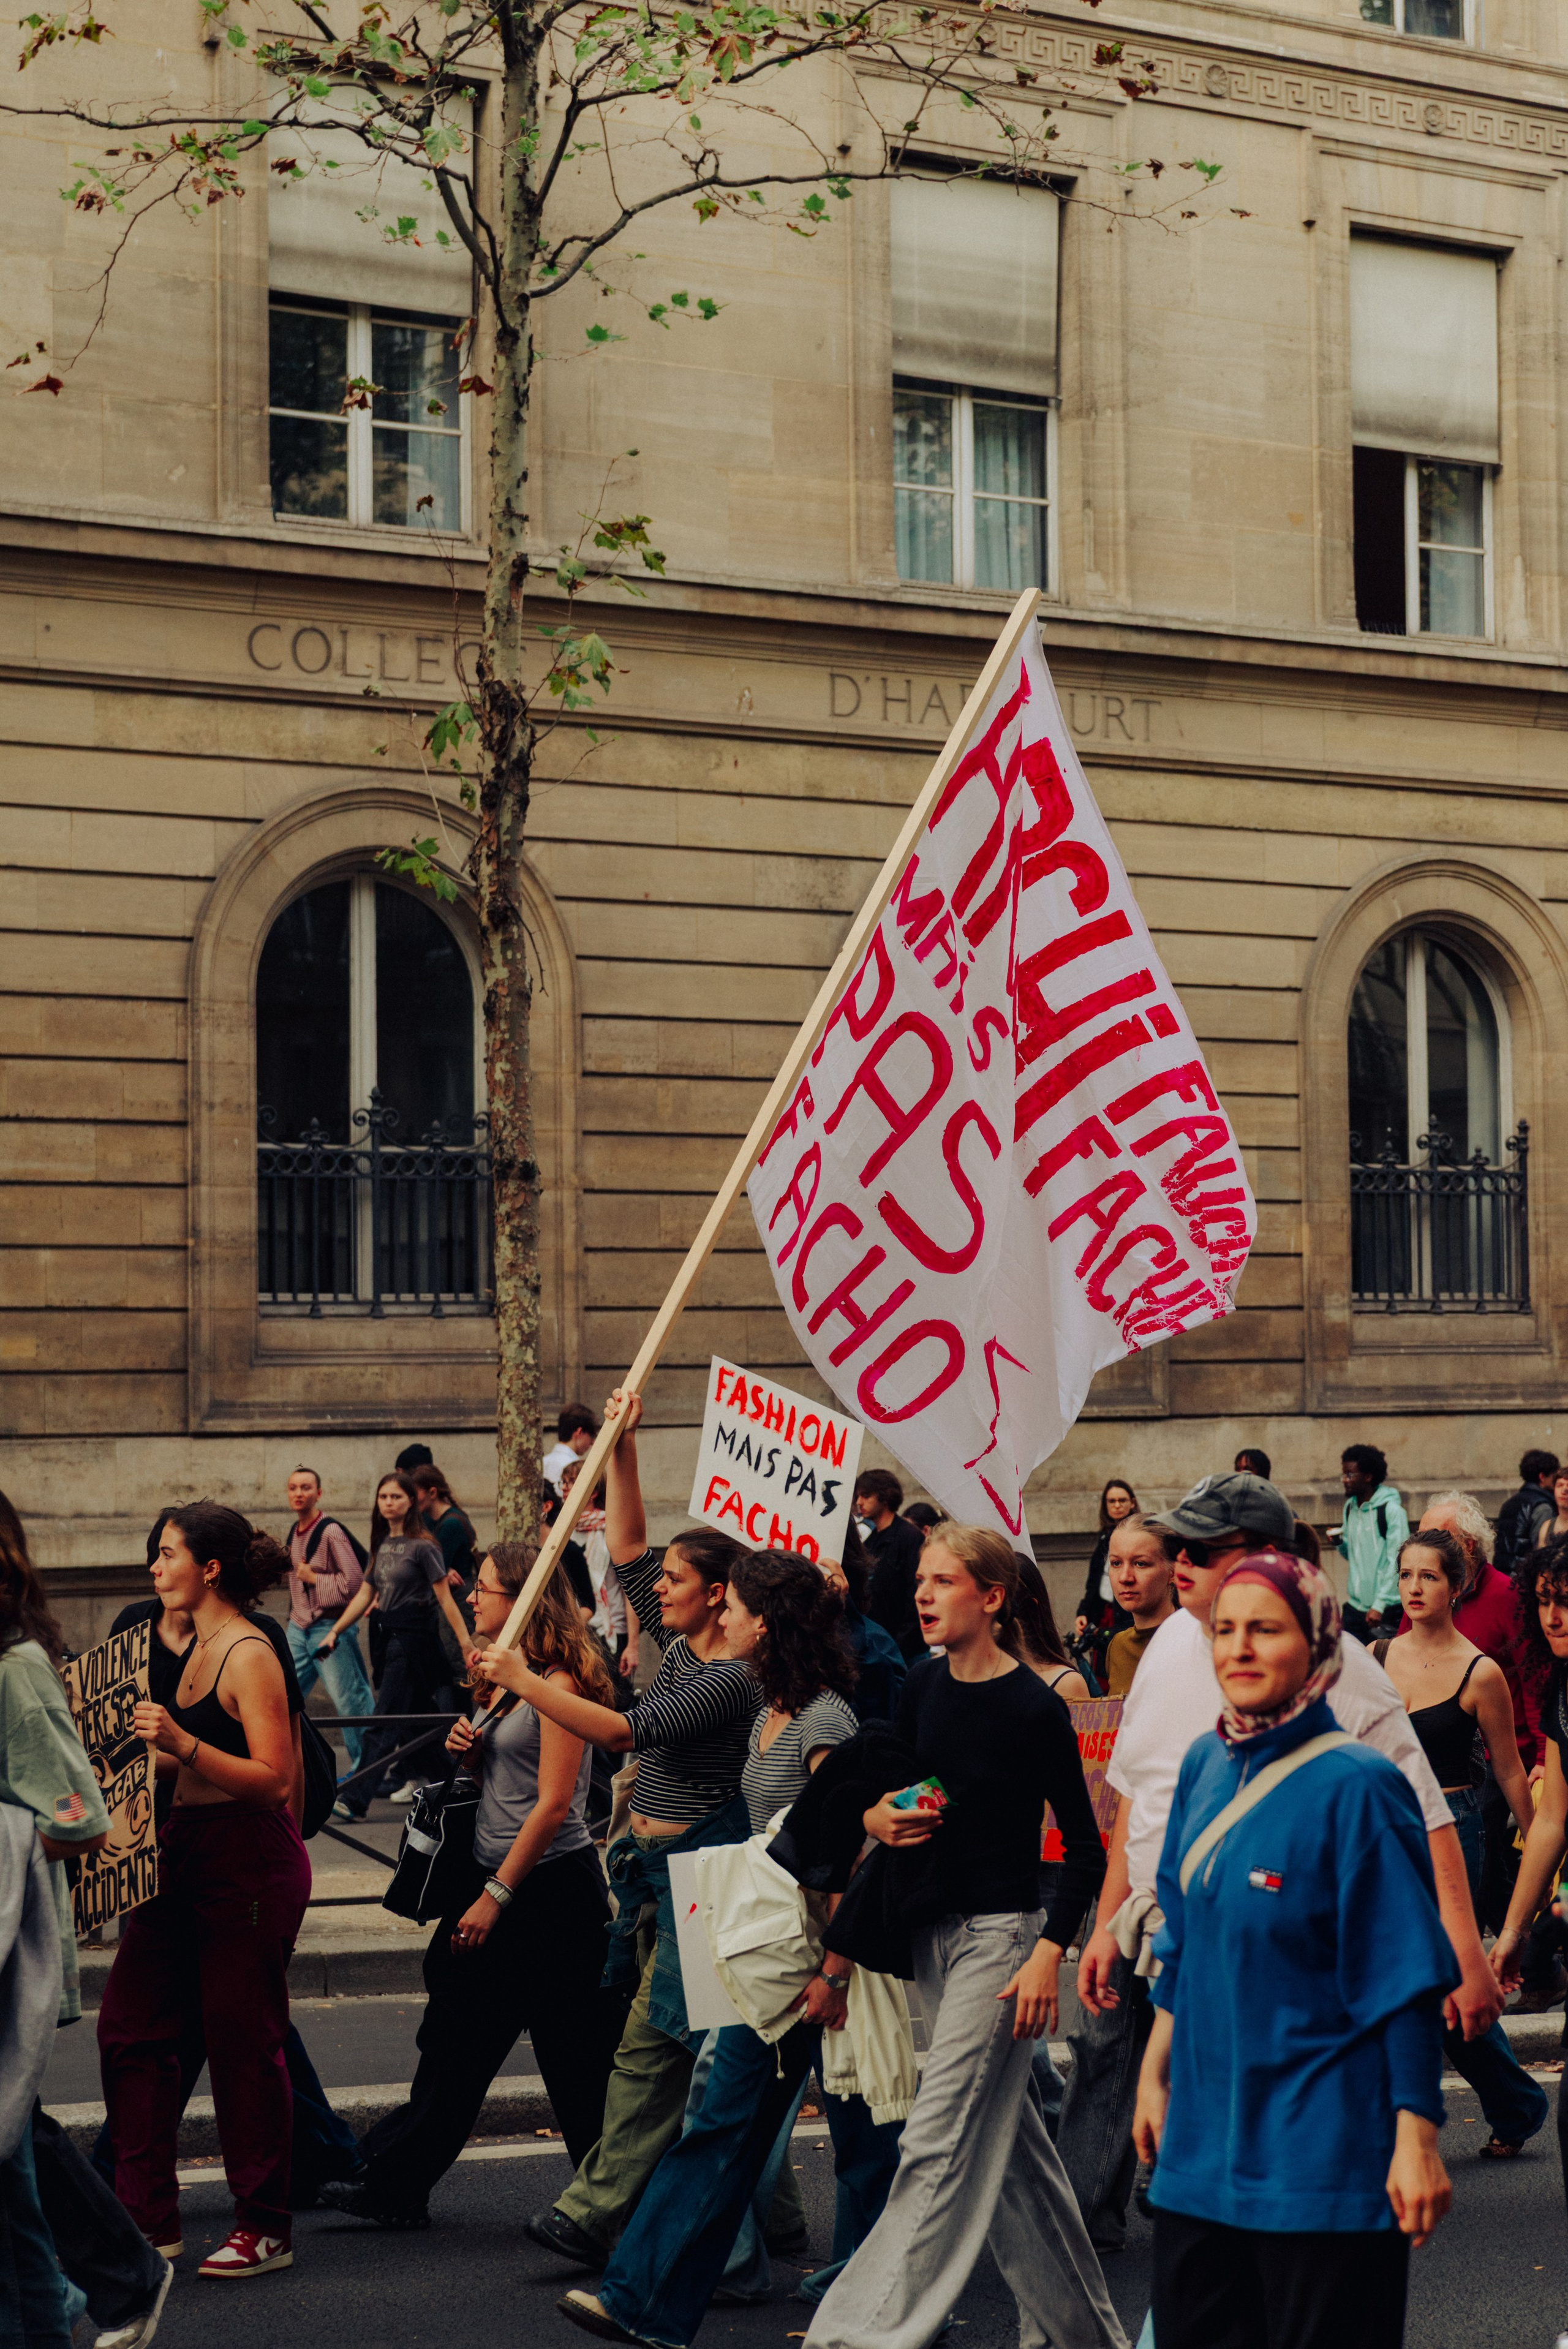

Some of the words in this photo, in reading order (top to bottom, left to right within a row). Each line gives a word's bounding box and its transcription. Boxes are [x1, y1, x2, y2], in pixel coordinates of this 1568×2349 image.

[247, 623, 526, 687] COLLEG
[829, 673, 1162, 742] D'HAURT
[812, 922, 1001, 1275] PAS
[758, 1076, 965, 1424] FACHO
[714, 1421, 782, 1477] MAIS
[785, 1455, 843, 1517] PAS
[715, 1366, 848, 1469] FASHION
[703, 1476, 820, 1564] FACHO
[105, 1760, 146, 1811] ACAB
